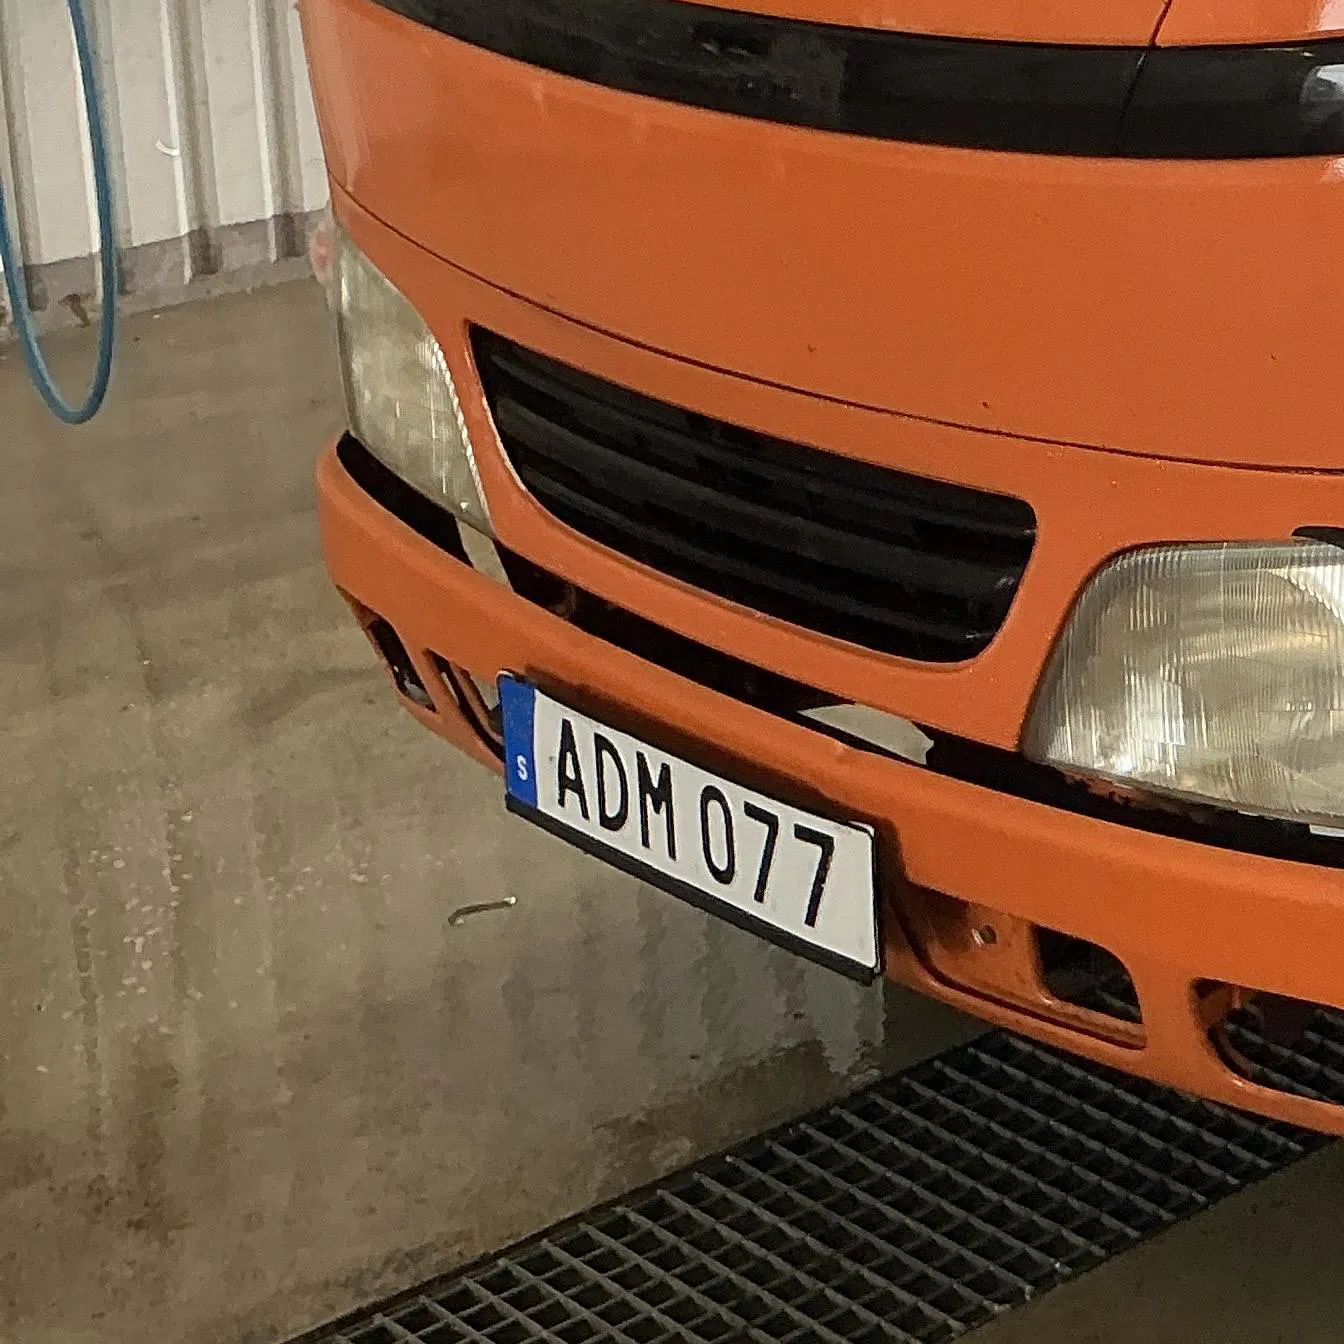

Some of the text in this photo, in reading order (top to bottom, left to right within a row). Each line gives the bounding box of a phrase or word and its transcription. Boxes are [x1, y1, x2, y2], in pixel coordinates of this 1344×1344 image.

[516, 755, 529, 781] S
[557, 718, 835, 928] ADM 077
